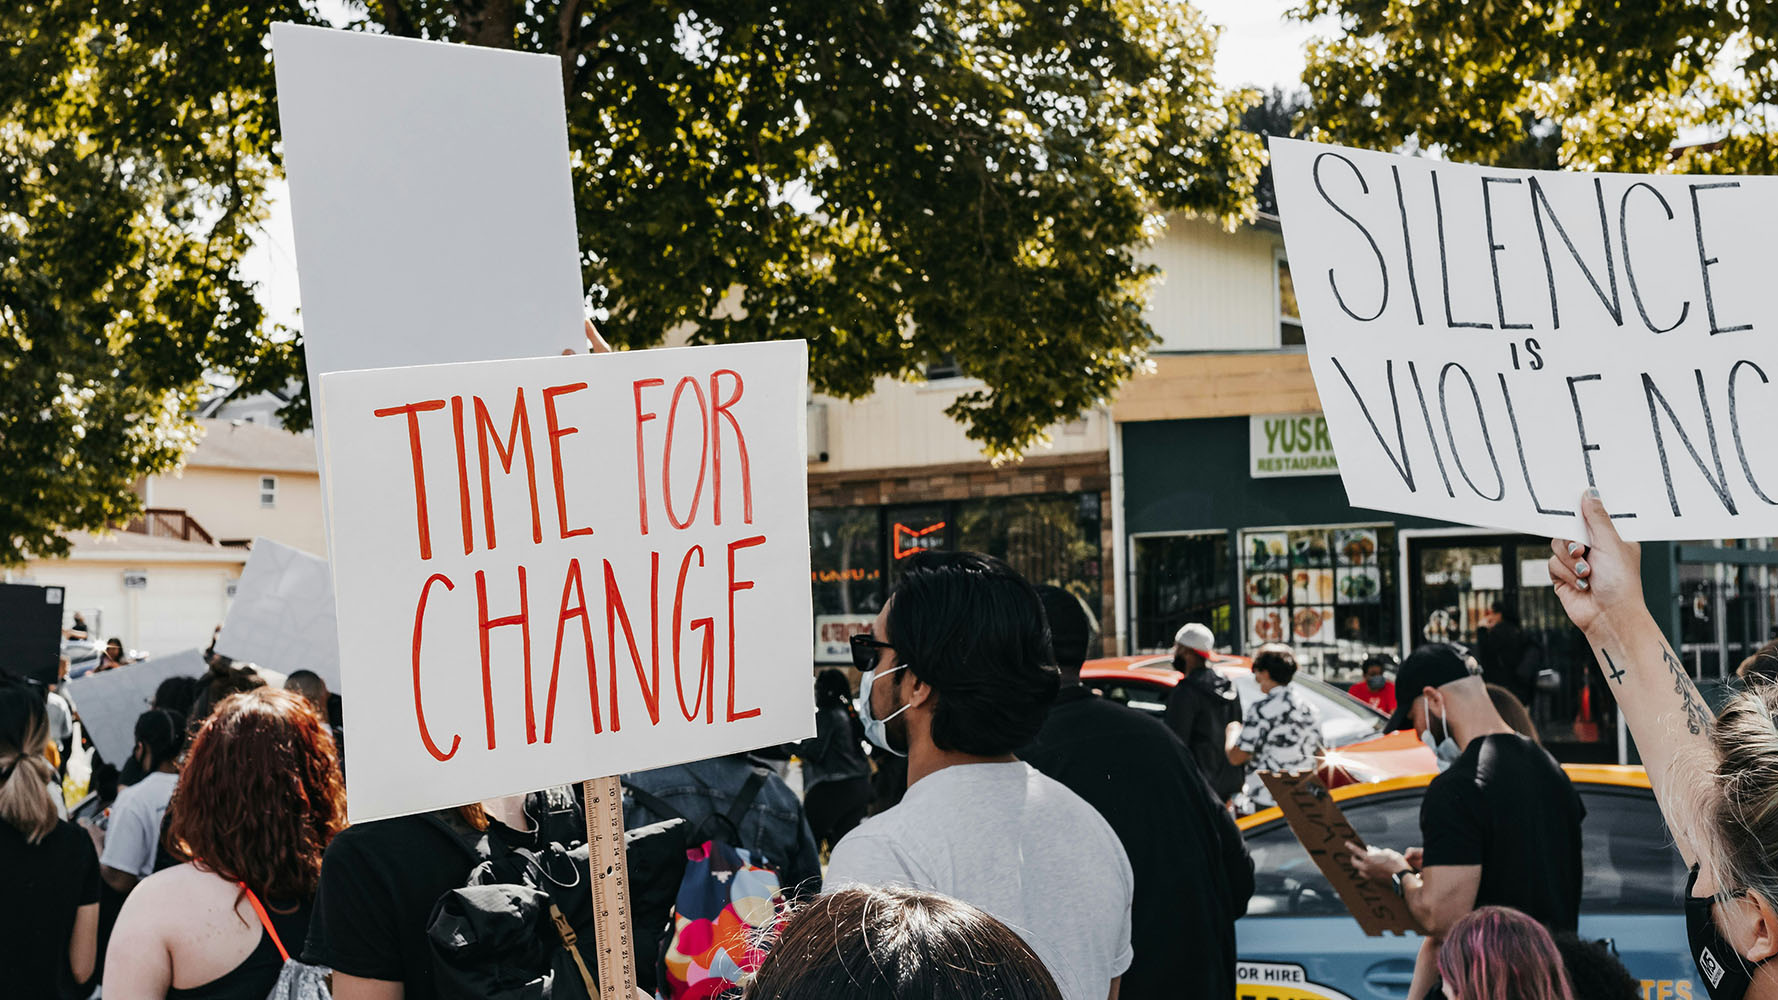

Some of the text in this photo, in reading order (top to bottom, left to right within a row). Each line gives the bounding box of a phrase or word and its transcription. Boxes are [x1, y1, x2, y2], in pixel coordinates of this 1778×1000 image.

[1312, 152, 1755, 337] SILENCE
[1508, 337, 1545, 371] IS
[1264, 416, 1333, 454] YUSR
[1330, 357, 1778, 519] VIOLENC
[374, 368, 753, 561] TIME FOR
[1257, 456, 1338, 471] RESTAURAN
[411, 535, 767, 762] CHANGE
[609, 788, 615, 797] 10
[610, 802, 617, 811] 11
[611, 817, 618, 827] 12
[612, 832, 619, 842] 13
[613, 847, 620, 856] 14
[614, 862, 621, 871] 15
[616, 877, 623, 886] 16
[617, 891, 624, 900] 17
[618, 906, 625, 916] 18
[619, 921, 626, 930] 19
[620, 935, 628, 945] 20
[621, 950, 629, 960] 21
[623, 964, 630, 975] 22
[1238, 967, 1301, 982] OR HIRE
[624, 979, 631, 990] 23
[1640, 979, 1693, 1000] TES
